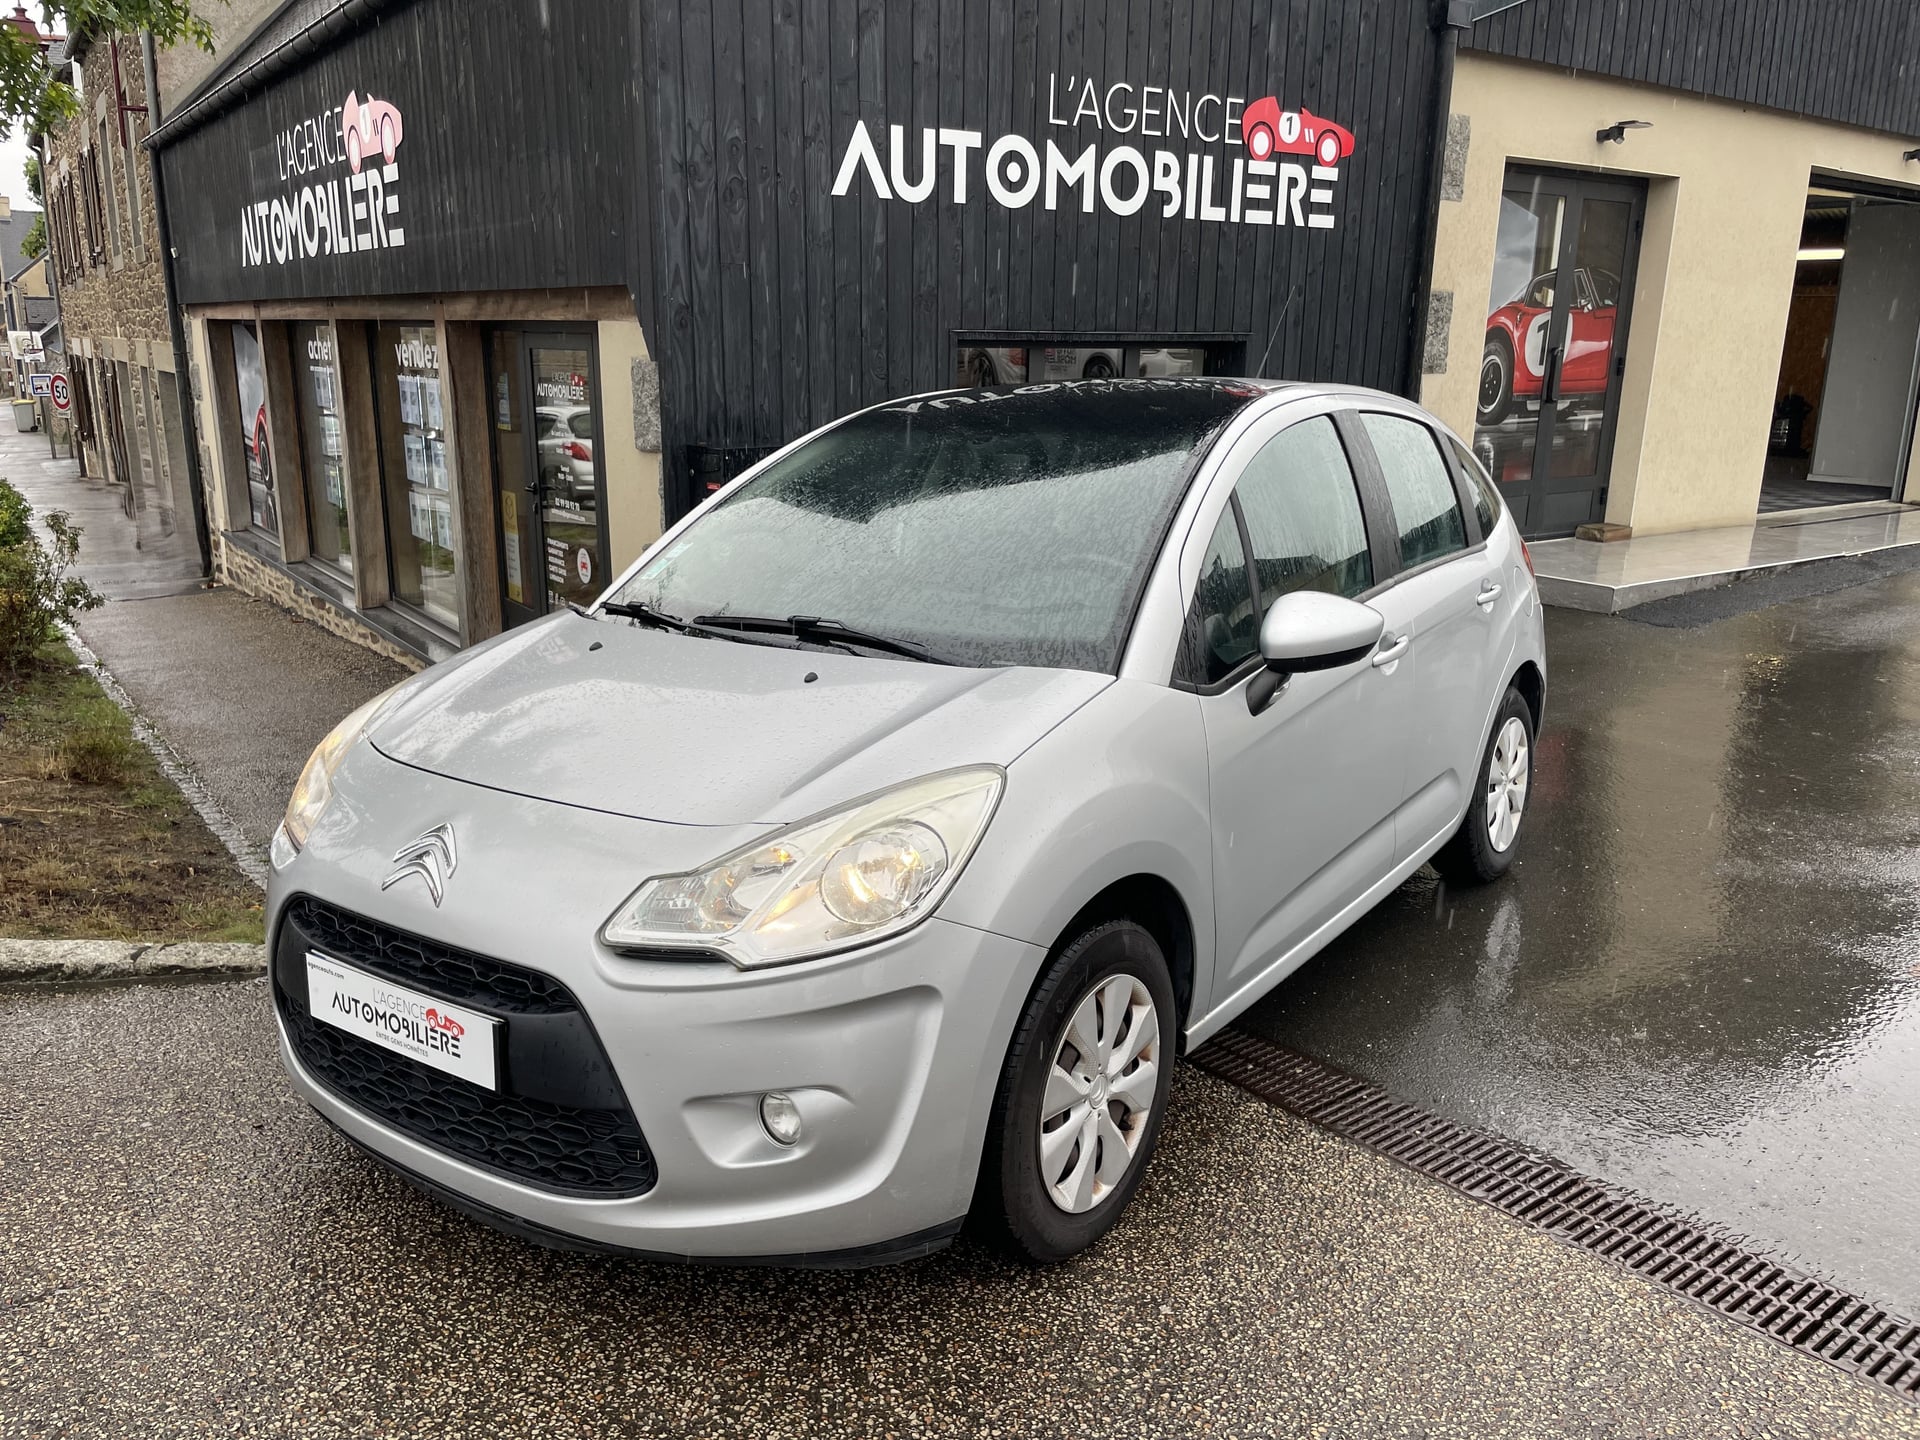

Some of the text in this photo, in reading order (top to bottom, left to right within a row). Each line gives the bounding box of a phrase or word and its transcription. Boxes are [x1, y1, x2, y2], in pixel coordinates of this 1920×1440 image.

[1048, 72, 1245, 145] L'AGENCE
[1285, 113, 1296, 138] 1
[276, 107, 346, 180] L'AGENCE
[831, 119, 1339, 229] AUTOMOBILIERE
[241, 162, 406, 267] AUTOMOBILIERE
[394, 338, 439, 369] vendez
[1537, 319, 1551, 367] 1
[55, 385, 68, 400] 50
[331, 990, 461, 1059] AUTOMOBILIERE
[373, 988, 427, 1021] L'AGENCE
